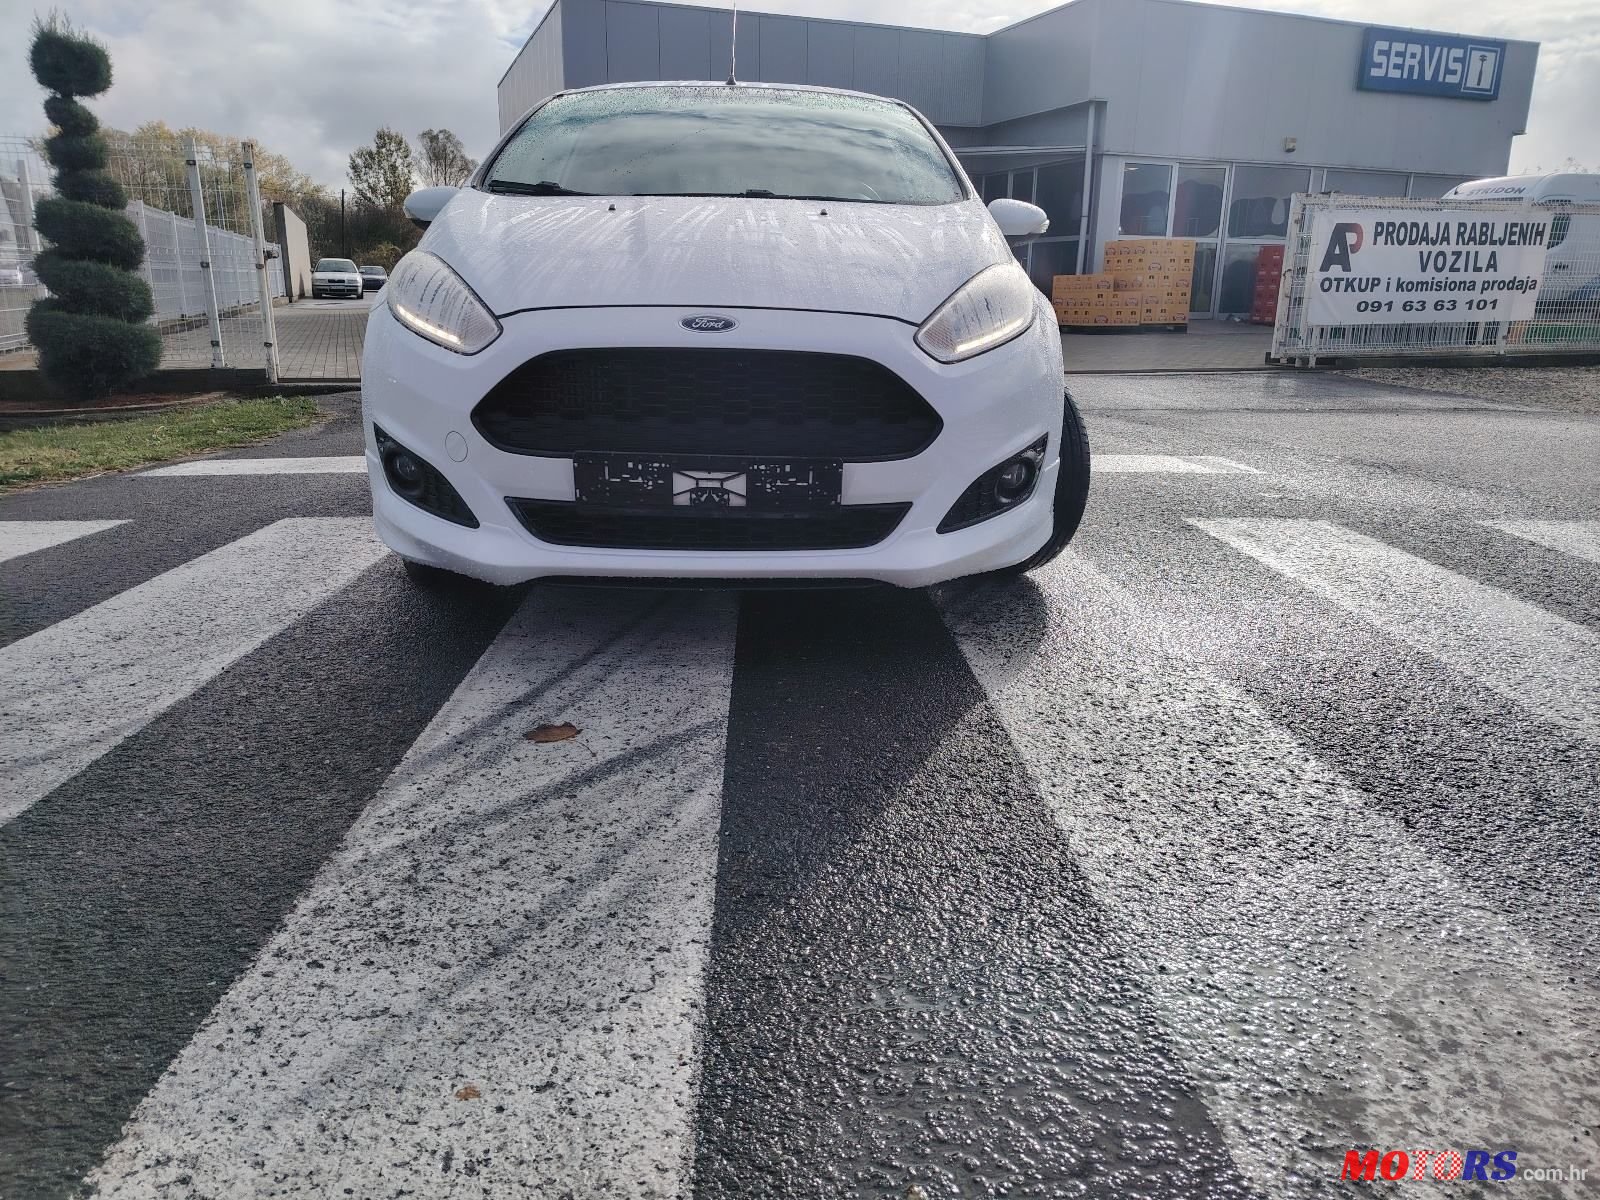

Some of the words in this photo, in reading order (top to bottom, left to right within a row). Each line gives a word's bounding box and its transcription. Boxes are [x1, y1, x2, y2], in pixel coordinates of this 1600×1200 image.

[1370, 40, 1465, 83] SERVIS
[1467, 187, 1526, 197] STRIDON
[1372, 221, 1451, 246] PRODAJA
[1455, 222, 1547, 246] RABLJENIH
[1419, 250, 1498, 273] VOZILA
[1319, 277, 1381, 293] OTKUP
[1385, 277, 1391, 292] i
[1396, 276, 1476, 292] komisiona
[1479, 275, 1538, 295] prodaja
[1356, 300, 1394, 313] 091
[1402, 300, 1427, 312] 63
[1433, 299, 1457, 311] 63
[1465, 299, 1498, 311] 101
[692, 318, 725, 328] Ford
